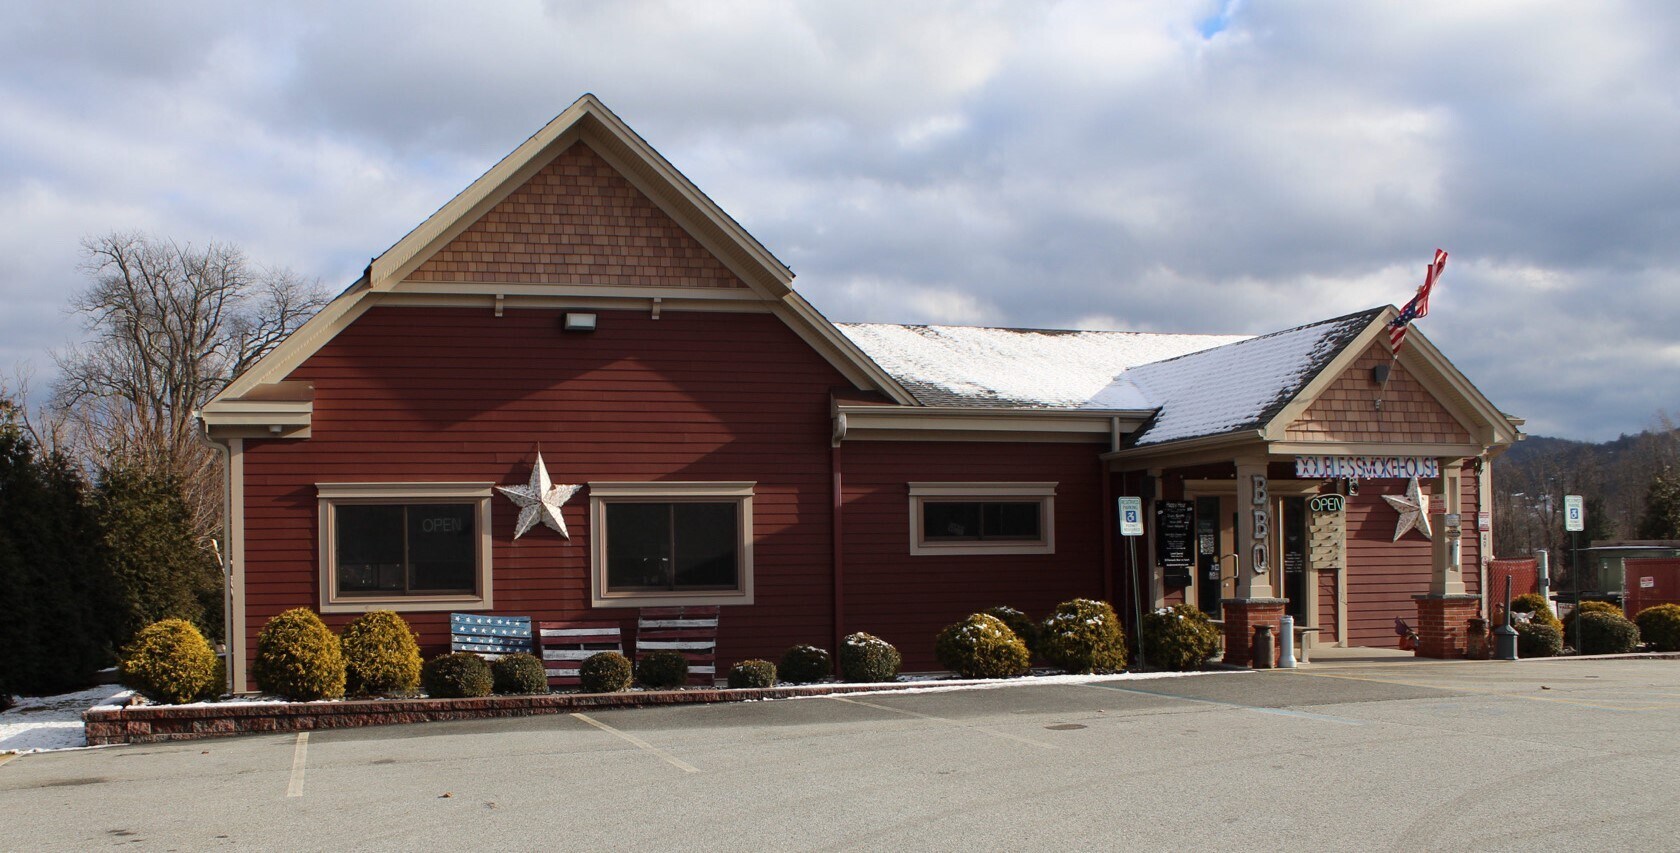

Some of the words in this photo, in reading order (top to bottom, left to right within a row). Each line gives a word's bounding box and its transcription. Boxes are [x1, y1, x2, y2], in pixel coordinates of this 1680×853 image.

[1310, 497, 1344, 512] OPEN
[423, 517, 462, 533] OPEN
[1253, 474, 1269, 574] BBQ
